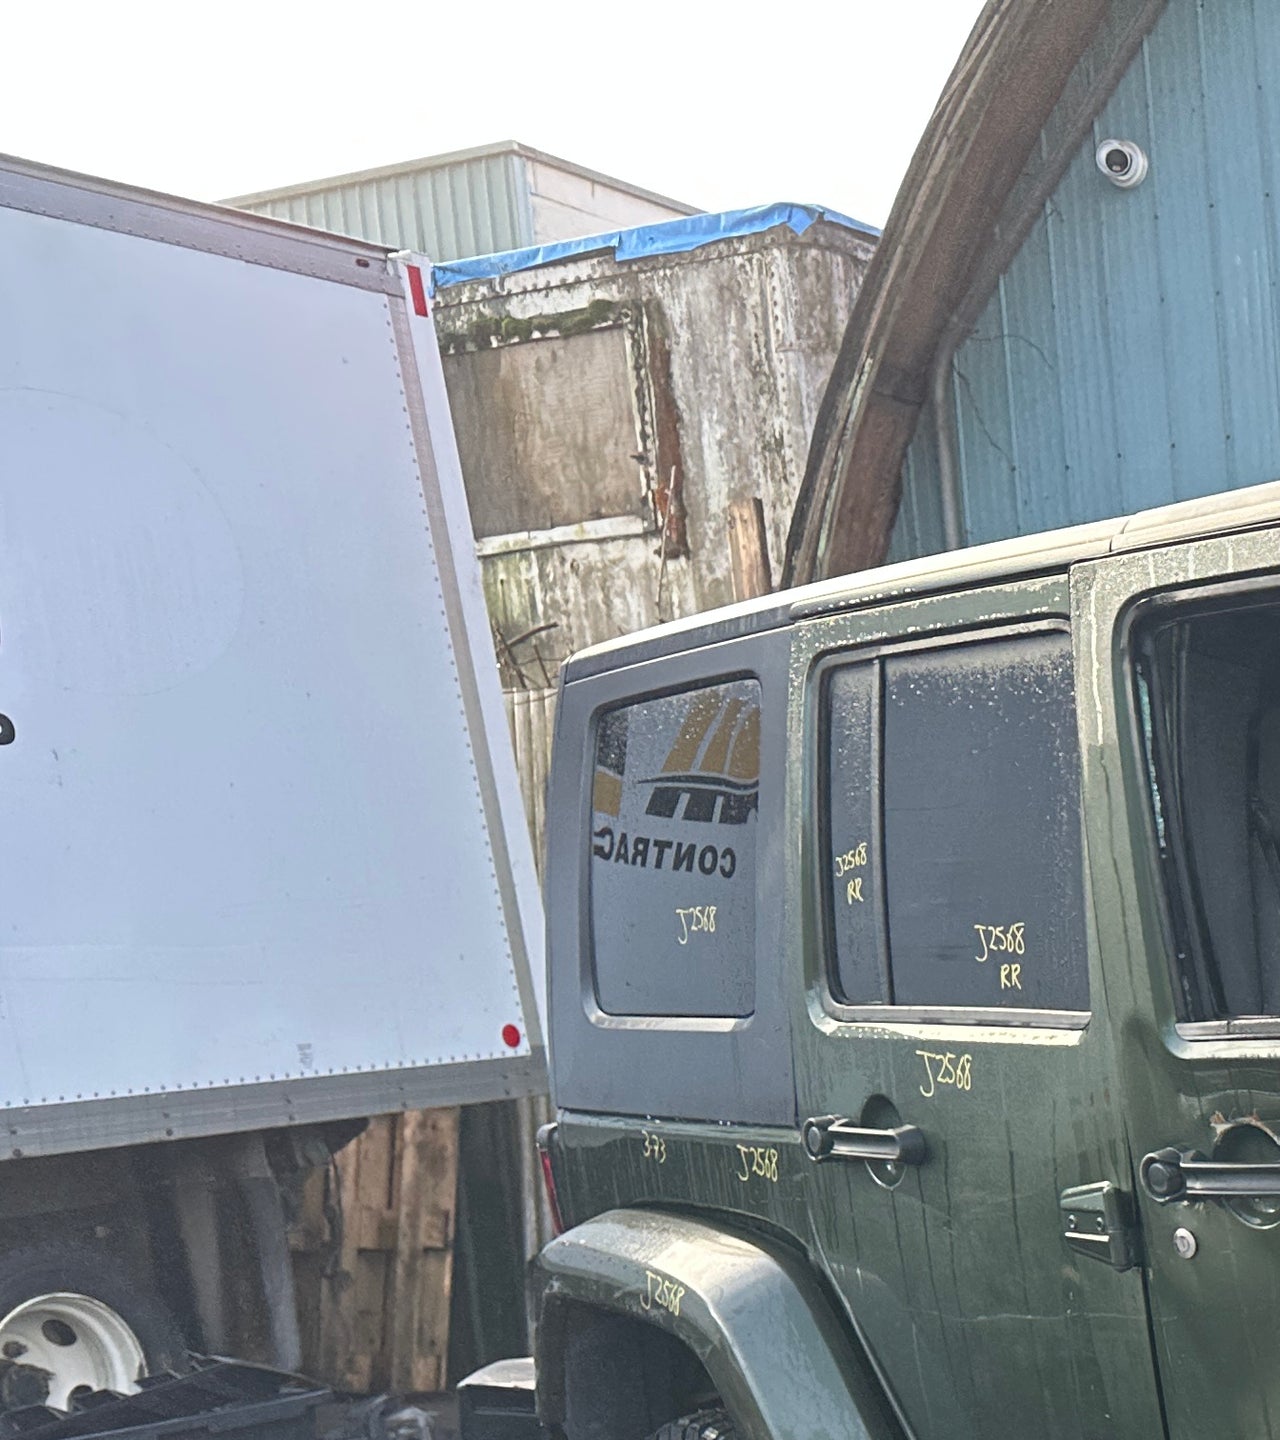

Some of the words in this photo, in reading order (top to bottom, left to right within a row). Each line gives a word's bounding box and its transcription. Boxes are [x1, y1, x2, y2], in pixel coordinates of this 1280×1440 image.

[835, 842, 868, 878] J2568
[847, 877, 864, 905] RR
[675, 905, 717, 945] J2568
[974, 922, 1025, 962] J2568
[1000, 963, 1022, 990] RR
[915, 1050, 972, 1097] J2568
[736, 1143, 778, 1182] J2568
[640, 1270, 685, 1316] J2568
